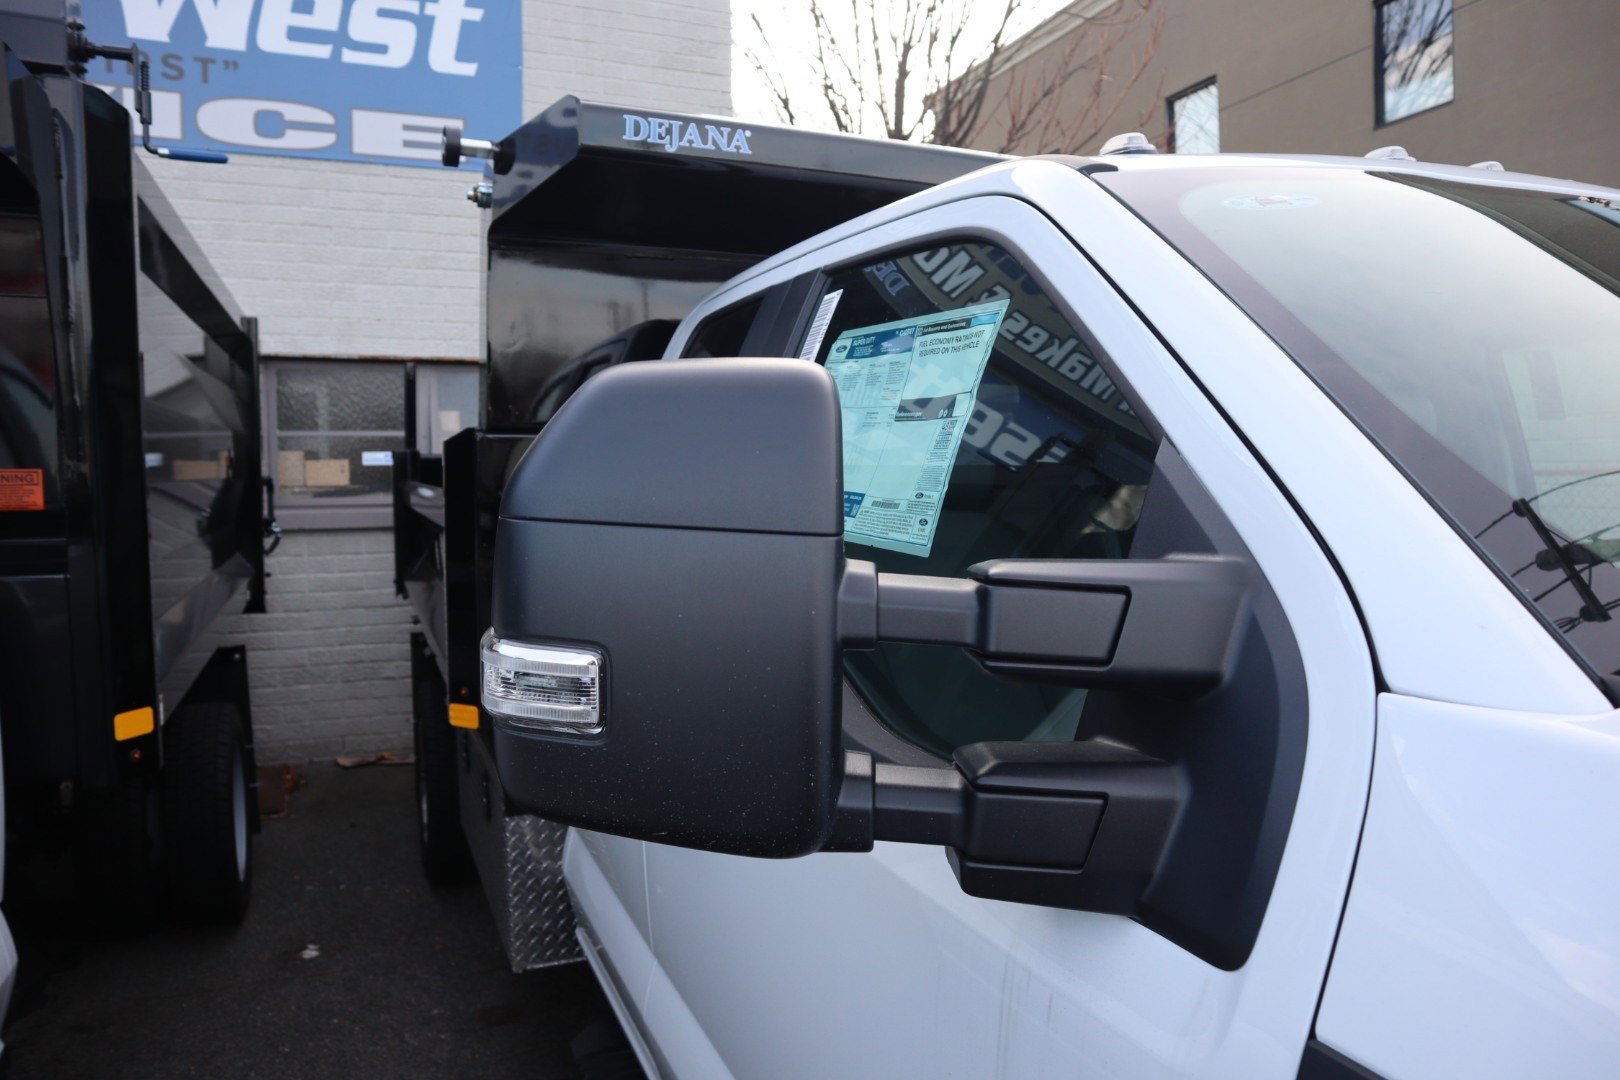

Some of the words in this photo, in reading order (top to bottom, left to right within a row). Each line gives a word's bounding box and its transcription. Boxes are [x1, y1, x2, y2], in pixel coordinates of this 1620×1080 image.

[120, 0, 485, 77] West
[92, 83, 466, 162] ICE
[929, 336, 955, 346] ECONOMY
[951, 343, 961, 354] THIS
